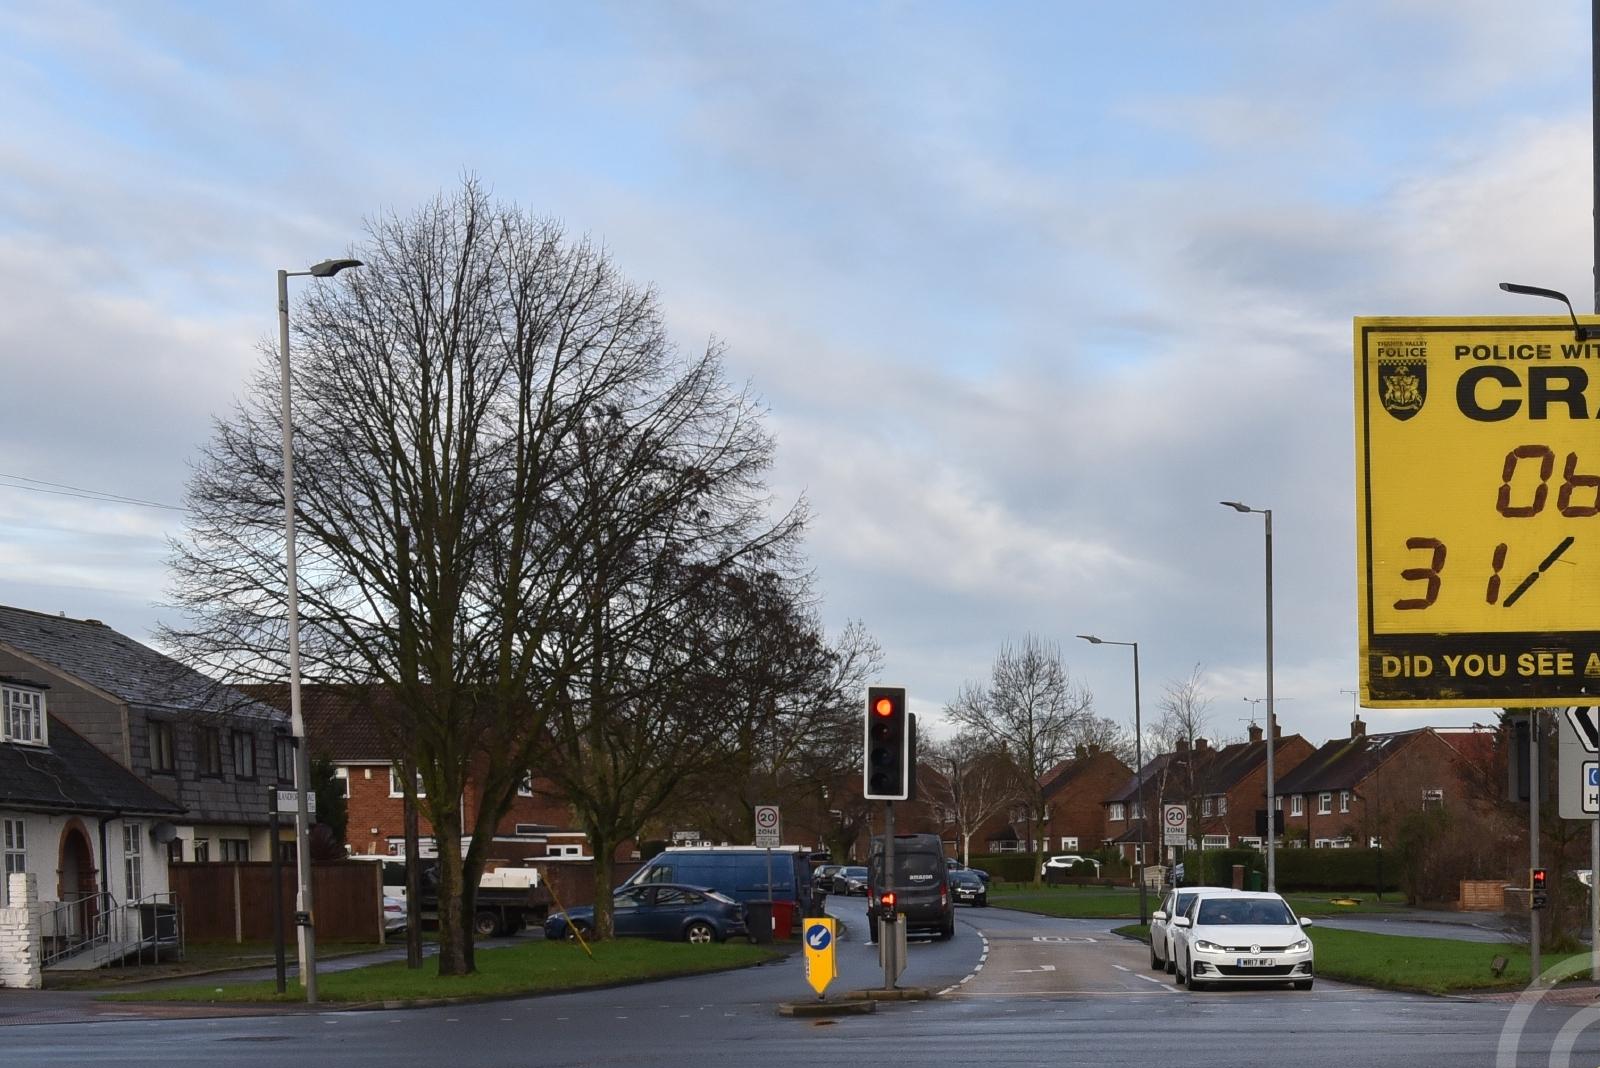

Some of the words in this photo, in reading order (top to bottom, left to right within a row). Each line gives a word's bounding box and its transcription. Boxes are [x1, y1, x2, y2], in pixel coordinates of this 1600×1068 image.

[1378, 347, 1427, 357] POLICE
[1455, 343, 1552, 361] POLICE
[1382, 655, 1433, 678] DID
[1443, 654, 1507, 677] YOU
[1517, 653, 1575, 676] SEE
[760, 813, 774, 821] 20
[1169, 812, 1182, 820] 20
